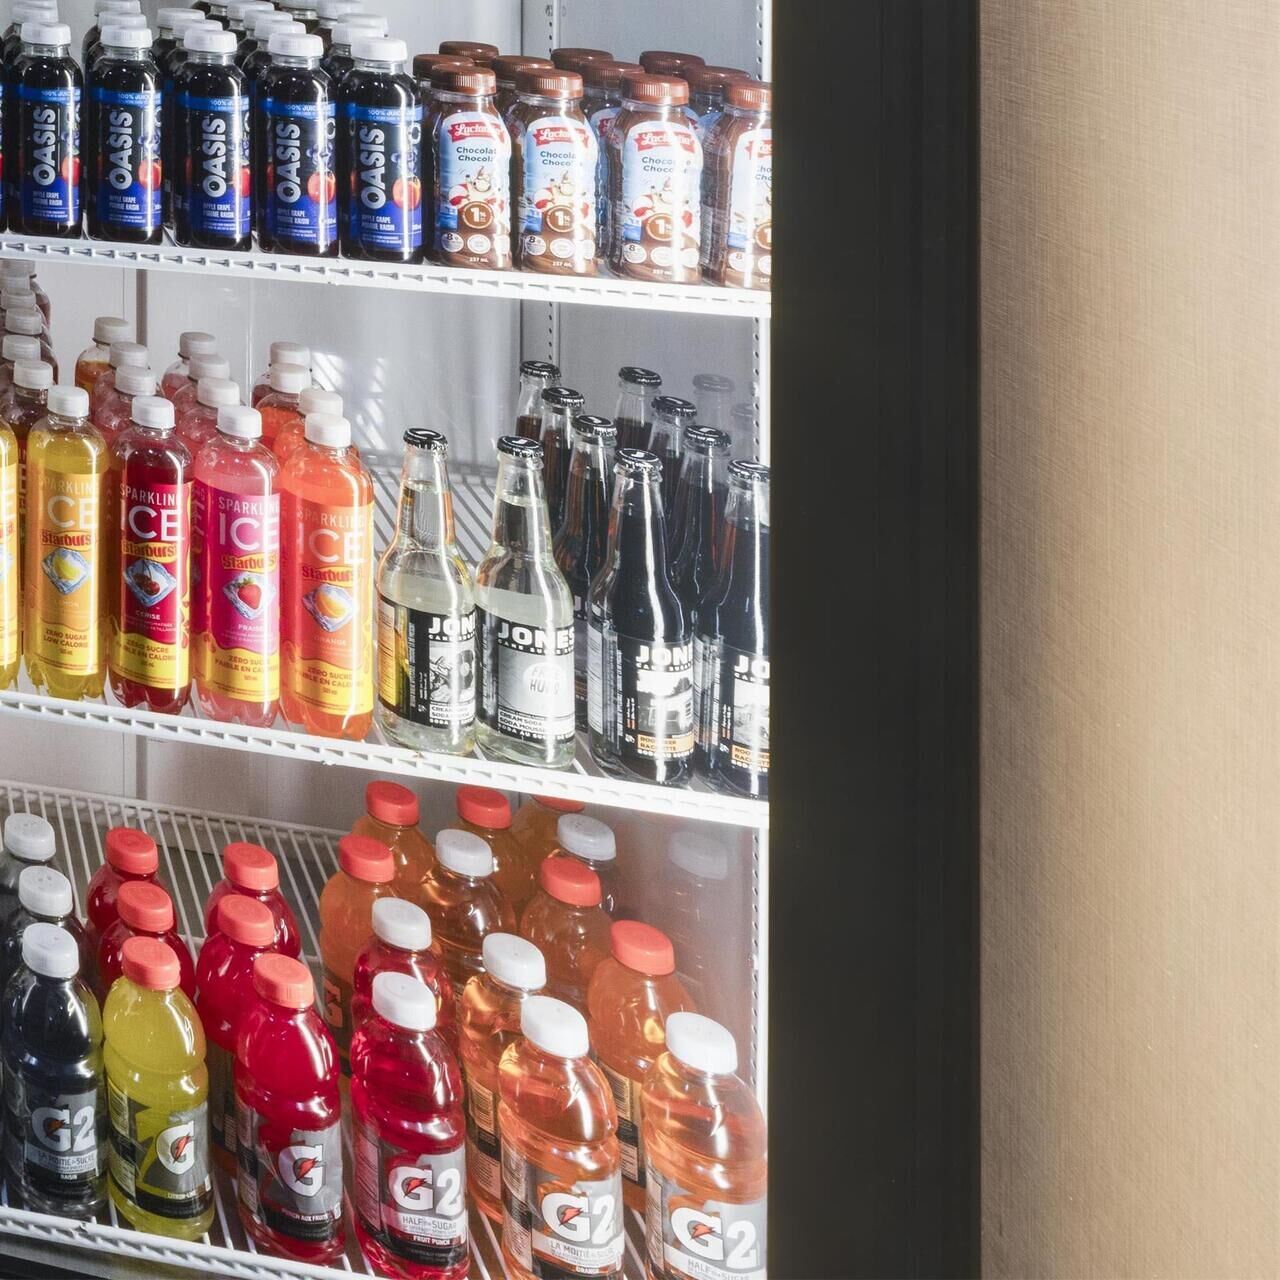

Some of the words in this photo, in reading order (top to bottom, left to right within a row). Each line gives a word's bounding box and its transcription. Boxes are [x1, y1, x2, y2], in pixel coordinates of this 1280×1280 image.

[32, 107, 57, 186] OASIS
[108, 110, 134, 190] OASIS
[201, 118, 227, 198] OASIS
[275, 123, 302, 204] OASIS
[359, 127, 387, 210] OASIS
[218, 512, 280, 552] ICE
[145, 644, 170, 654] SUCRE
[238, 623, 264, 632] FRAISE
[497, 622, 575, 649] JONES
[31, 1105, 96, 1153] G2
[155, 1120, 196, 1175] G
[60, 1173, 78, 1181] RAISIN
[278, 1144, 324, 1198] G
[388, 1166, 462, 1217] G2
[401, 1216, 422, 1226] HALF
[431, 1219, 457, 1231] SUGAR
[412, 1235, 432, 1245] FRUIT
[432, 1237, 451, 1246] PUNCH
[541, 1191, 617, 1246] G2
[670, 1206, 759, 1271] G2
